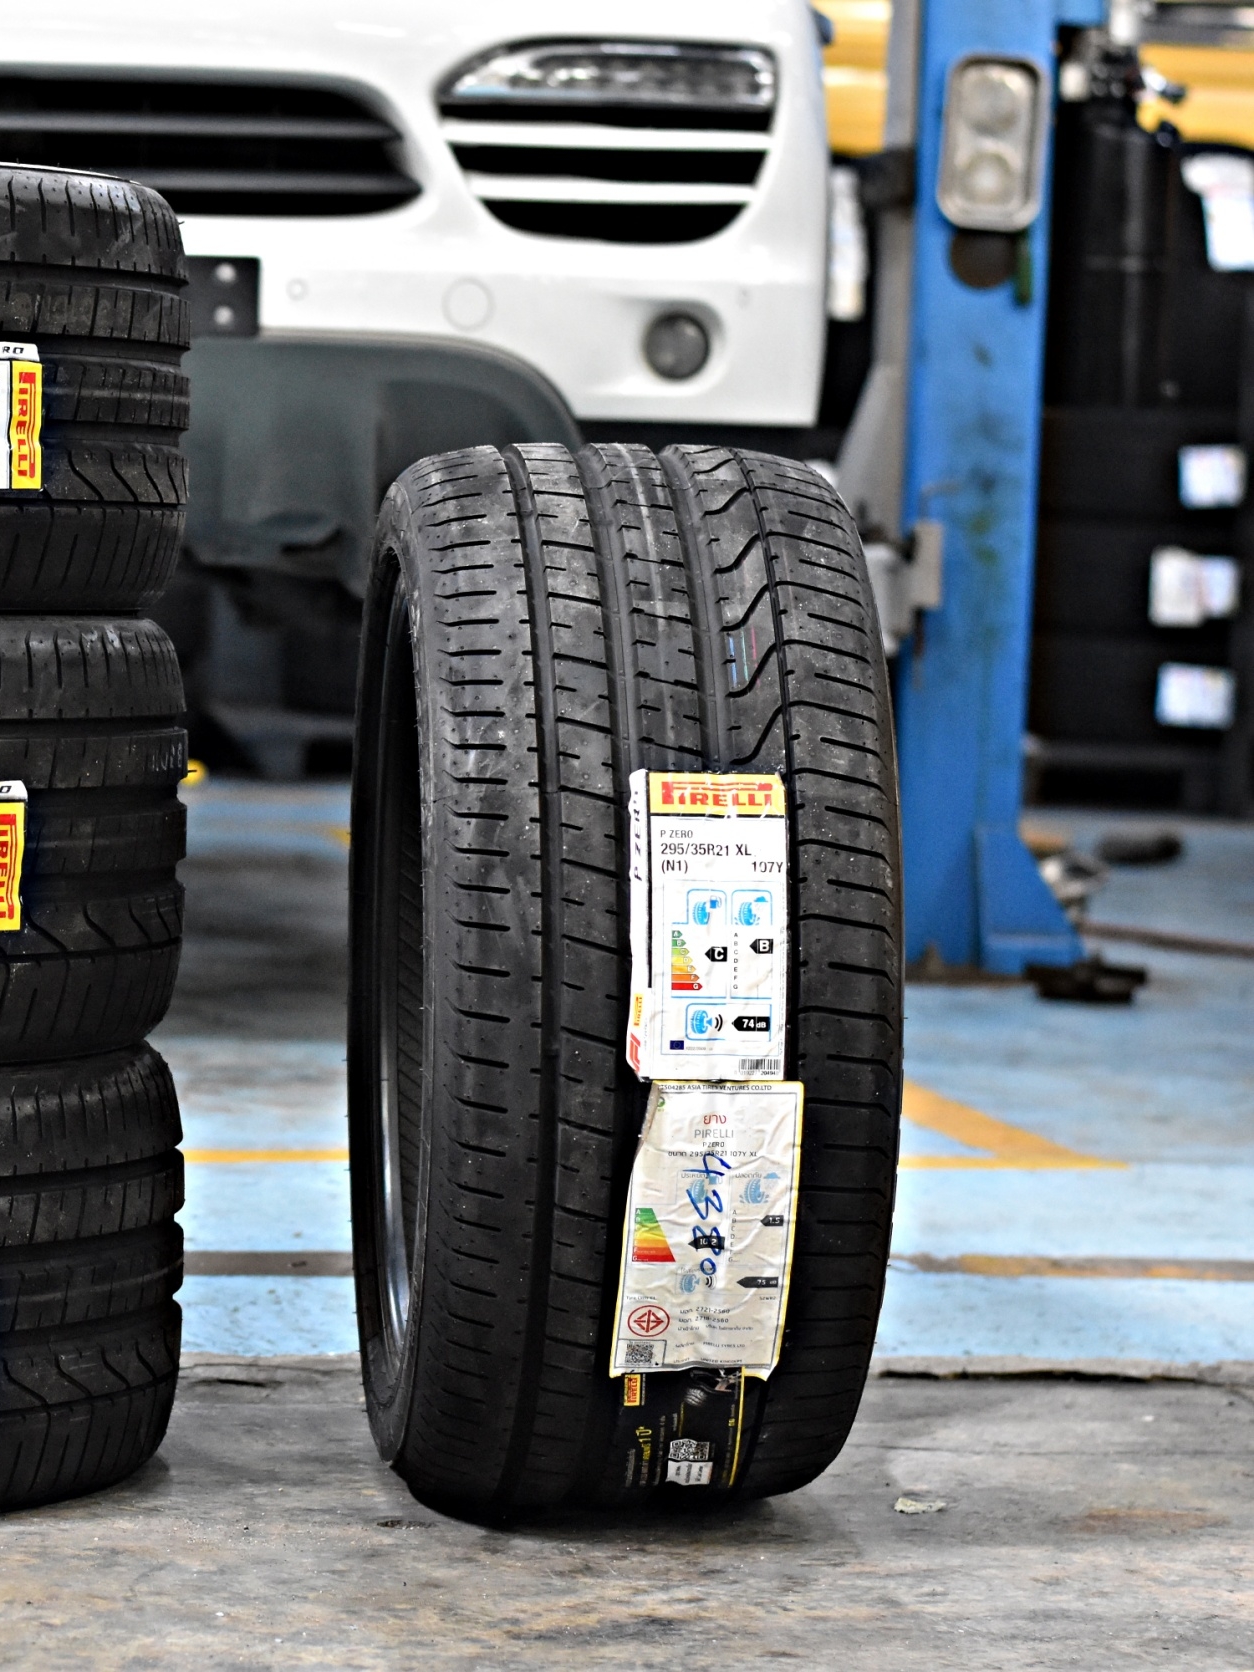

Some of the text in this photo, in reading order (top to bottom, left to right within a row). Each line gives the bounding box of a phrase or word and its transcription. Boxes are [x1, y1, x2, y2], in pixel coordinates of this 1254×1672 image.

[16, 372, 36, 478] PIRELLI
[661, 781, 774, 806] PIRELLI
[660, 830, 693, 838] P ZERO
[660, 843, 752, 856] 295/35R21 XL
[661, 860, 783, 874] (N1) 107Y
[759, 940, 770, 951] B
[714, 947, 724, 960] C
[742, 1019, 754, 1029] 74
[704, 1114, 727, 1124] ยาง
[694, 1129, 734, 1138] PIRELLI
